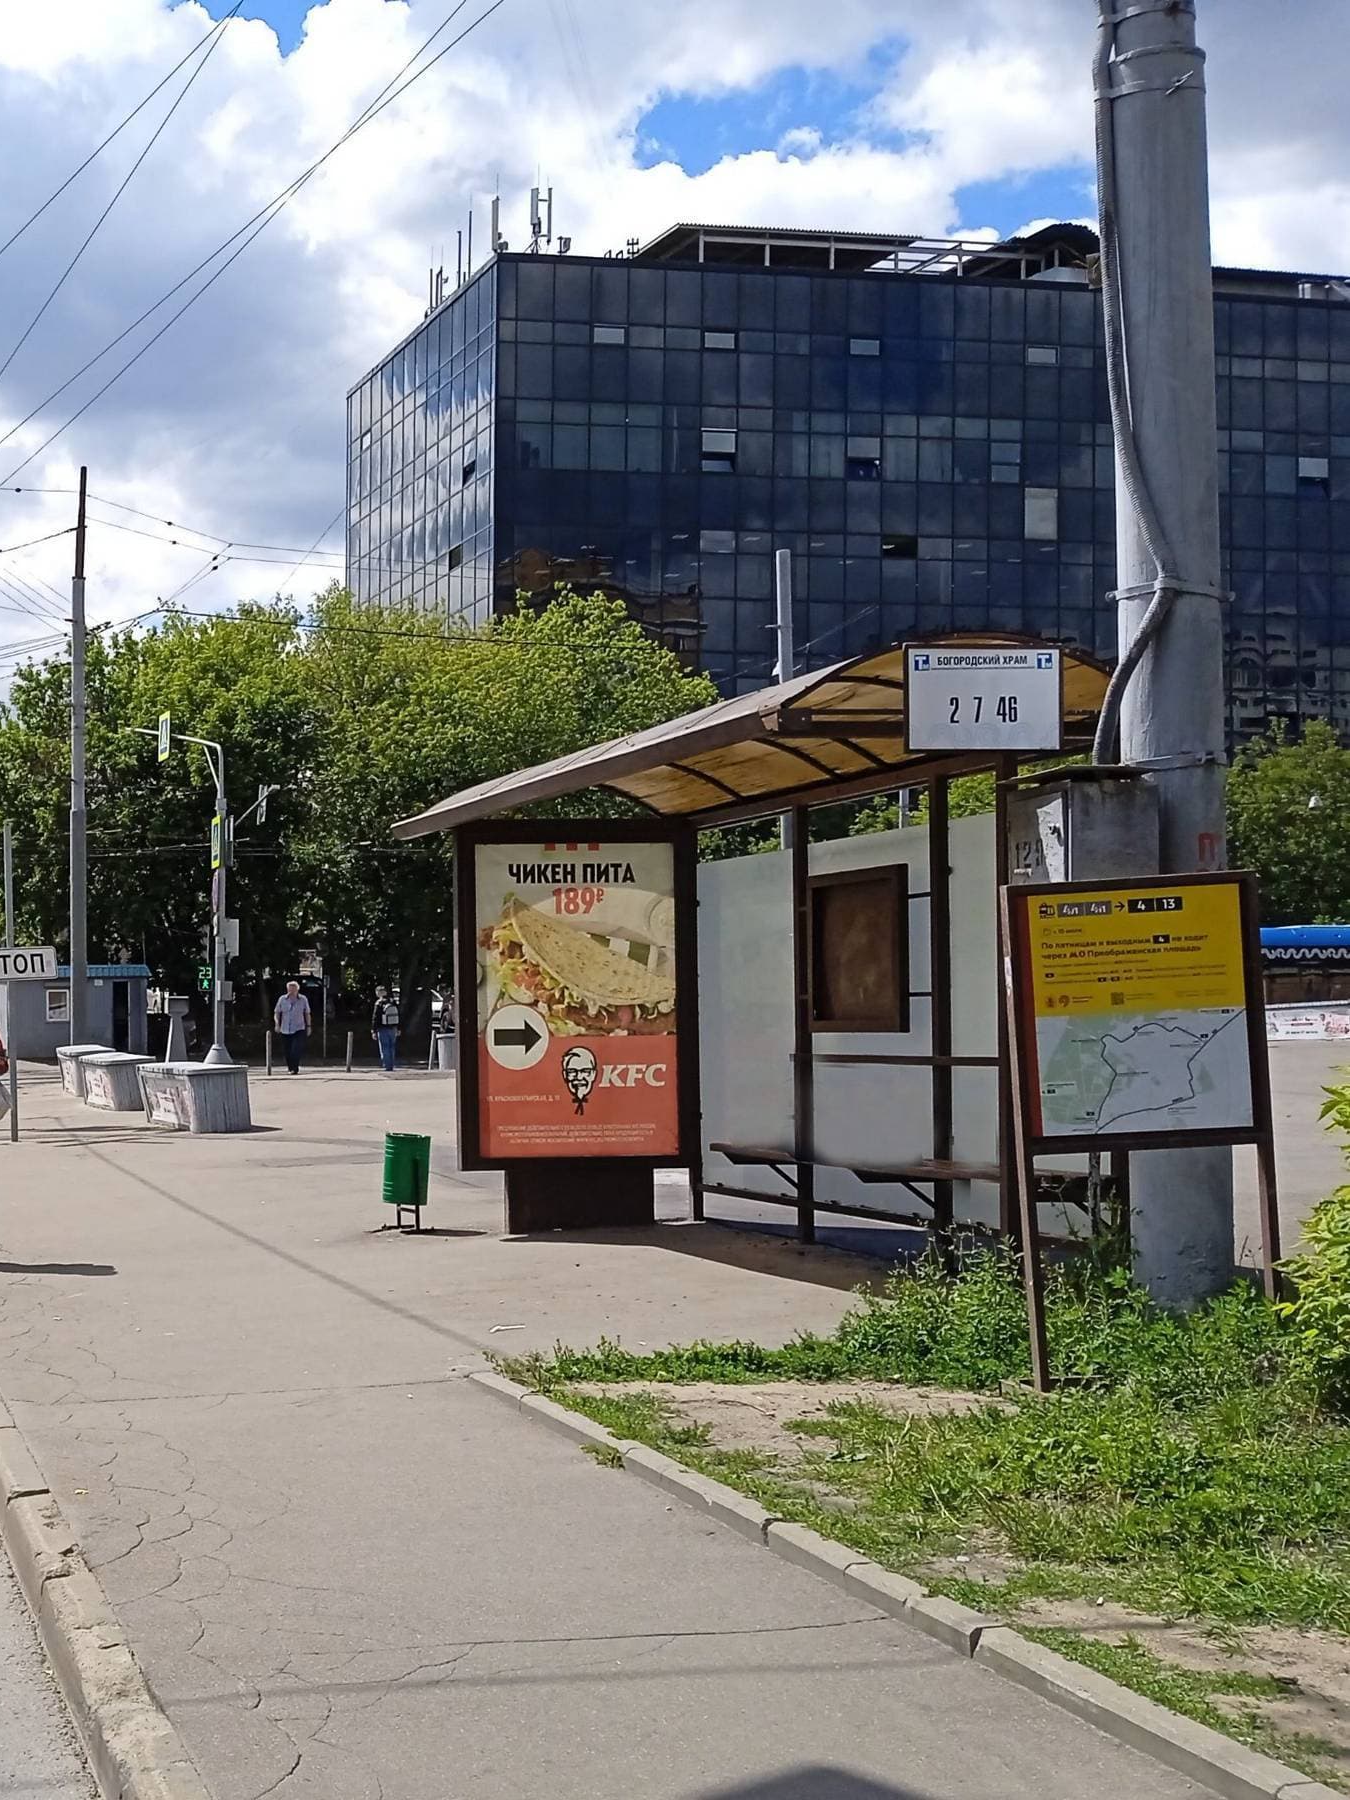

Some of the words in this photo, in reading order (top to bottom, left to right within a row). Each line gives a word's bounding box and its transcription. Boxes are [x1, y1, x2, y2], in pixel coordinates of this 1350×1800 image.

[937, 655, 1000, 666] БОГОРОДСКИЙ
[1003, 655, 1028, 665] ХРАМ
[950, 697, 960, 724] 2
[973, 697, 983, 723] 7
[996, 696, 1018, 723] 46
[508, 863, 576, 884] ЧИКЕН
[582, 863, 636, 884] ПИТА
[1137, 900, 1146, 911] 4
[1162, 898, 1176, 910] 13
[1088, 947, 1162, 957] Преображенская
[198, 967, 212, 979] 23
[598, 1063, 667, 1088] KFC
